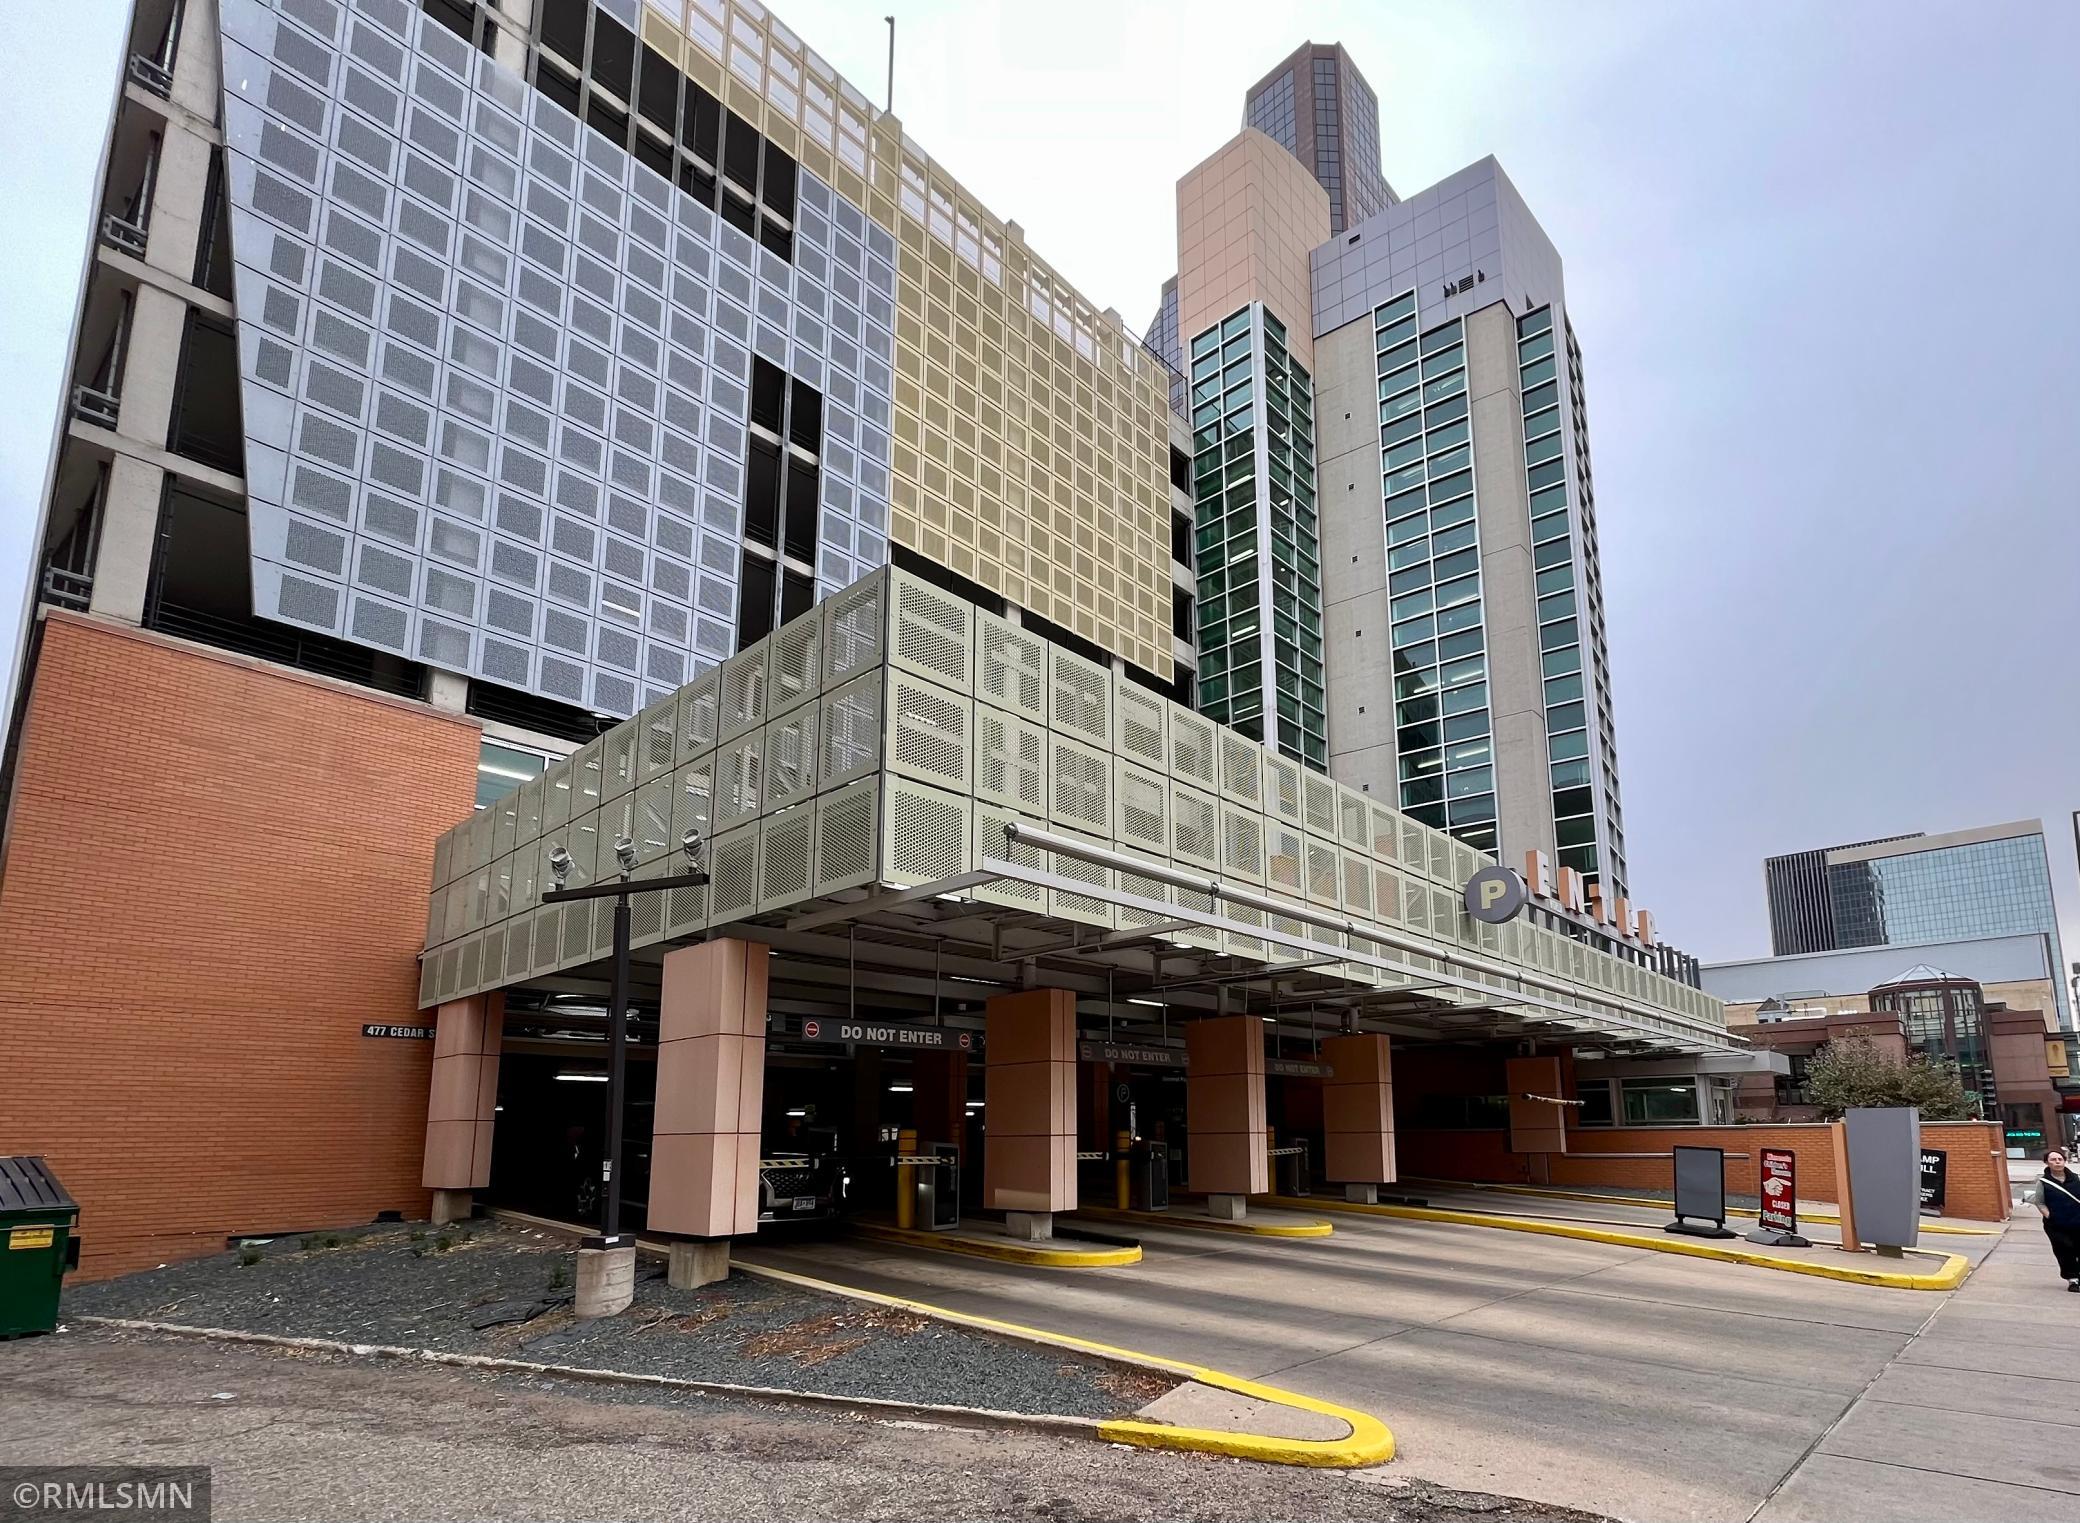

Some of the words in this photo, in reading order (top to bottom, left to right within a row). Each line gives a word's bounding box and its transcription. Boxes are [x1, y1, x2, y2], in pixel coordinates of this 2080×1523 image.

[1480, 879, 1506, 910] P
[367, 1026, 386, 1036] 477
[390, 1027, 424, 1038] CEDAR
[841, 1025, 862, 1040] DO
[866, 1028, 896, 1042] NOT
[899, 1030, 942, 1045] ENTER
[1105, 1048, 1119, 1059] DO
[1121, 1049, 1140, 1061] NOT
[1142, 1051, 1171, 1063] ENTER
[1920, 1155, 1940, 1164] MP
[1763, 1209, 1792, 1228] Parking
